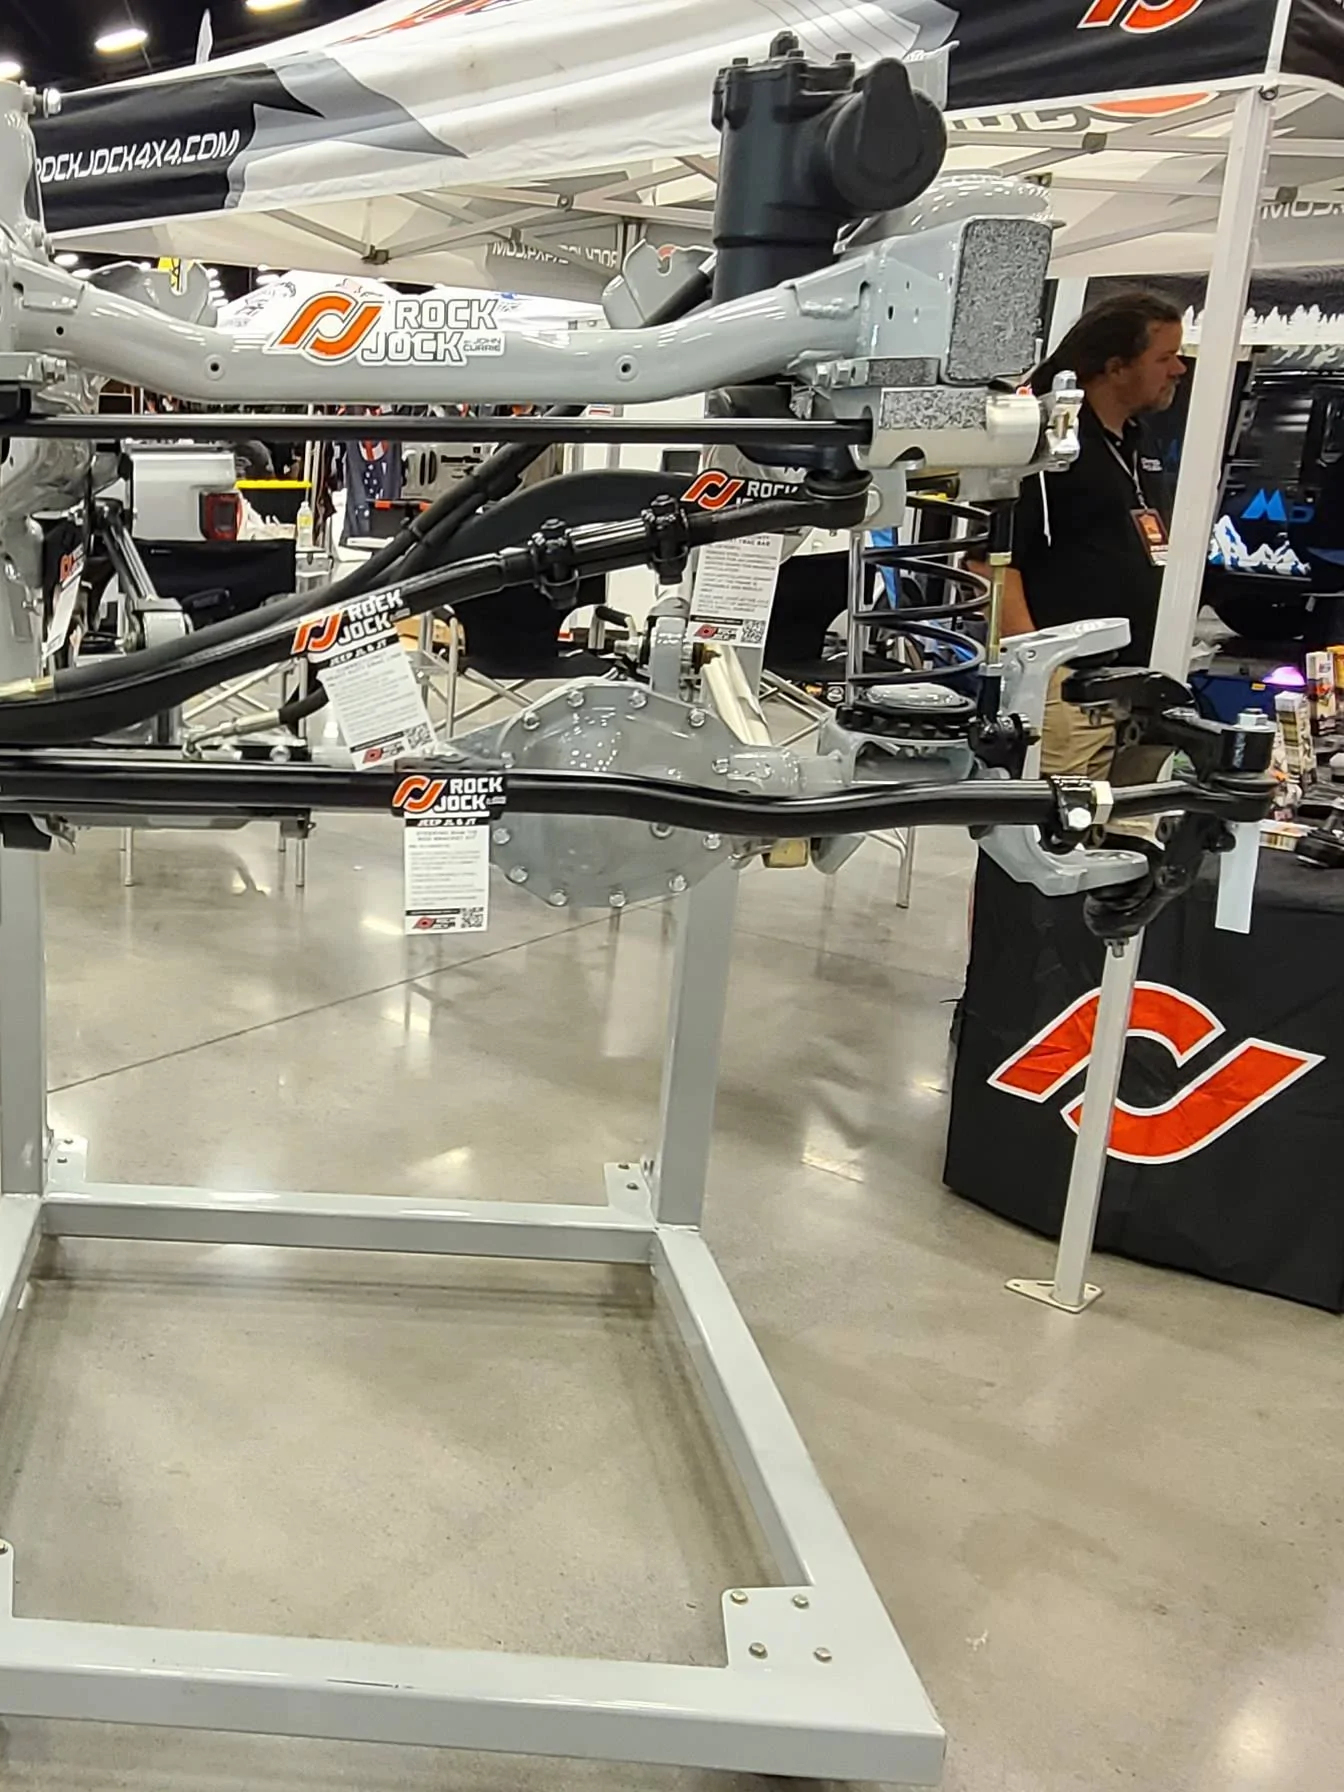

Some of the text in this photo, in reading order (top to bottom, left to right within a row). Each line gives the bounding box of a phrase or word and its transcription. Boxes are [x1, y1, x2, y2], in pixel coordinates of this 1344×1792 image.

[395, 299, 499, 330] ROCK
[361, 331, 464, 362] JOCK
[347, 589, 404, 621] ROCK
[338, 612, 391, 644] JOCK
[450, 777, 503, 794] ROCK
[433, 794, 487, 811] JOCK
